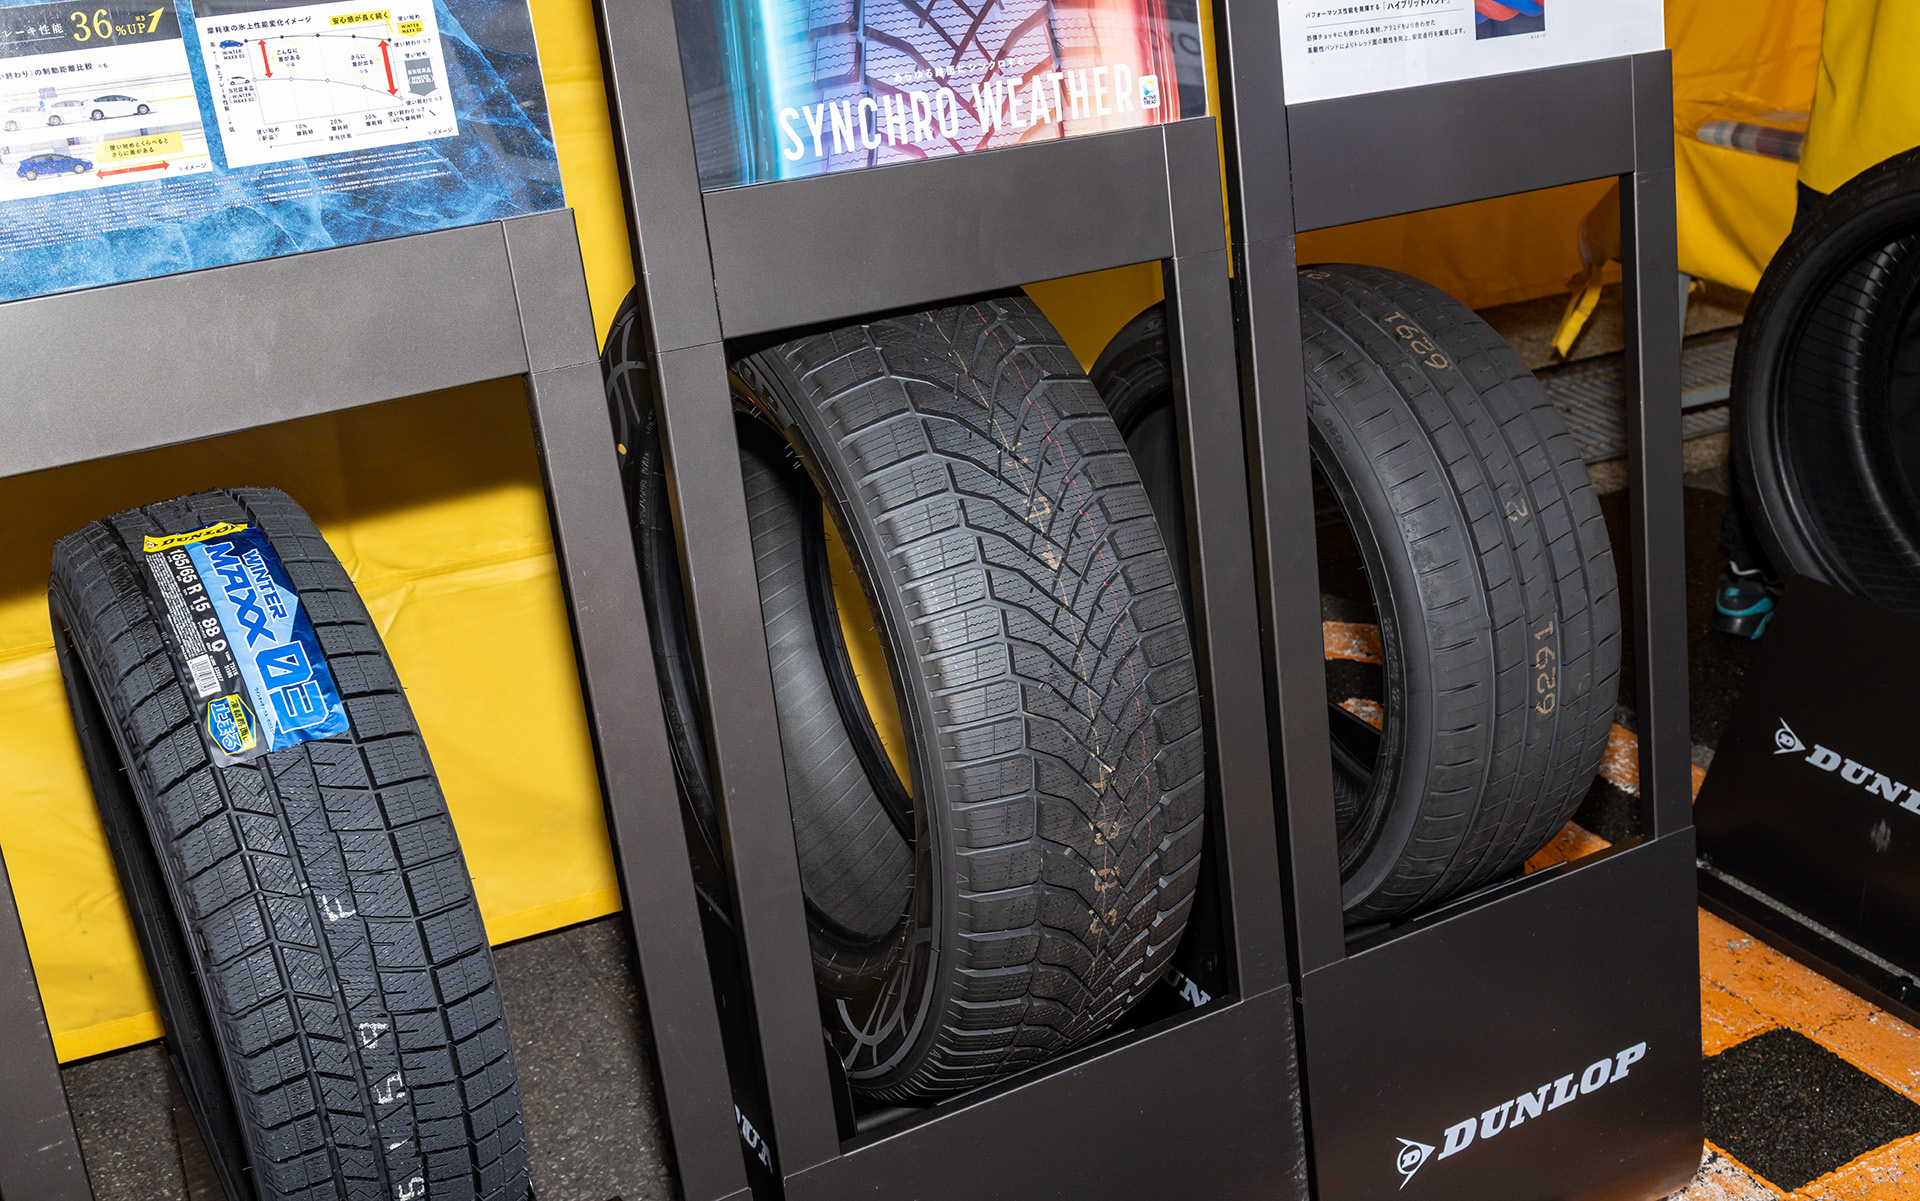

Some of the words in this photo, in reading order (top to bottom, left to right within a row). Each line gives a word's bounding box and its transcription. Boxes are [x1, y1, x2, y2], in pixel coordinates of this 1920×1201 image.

[206, 16, 312, 35] 摩耗後の氷上性能変化イメージ
[331, 11, 388, 25] 安心感が長く続く
[893, 57, 1025, 83] あらゆる路面にシンクロする
[778, 87, 959, 162] SYNCHRO
[972, 63, 1133, 133] WEATHER
[170, 548, 198, 586] 185/65
[242, 548, 288, 623] WINTER
[187, 584, 203, 595] R
[192, 596, 210, 612] 15
[203, 541, 279, 652] MAXX
[202, 617, 221, 639] 88
[211, 639, 227, 653] Q
[1534, 621, 1556, 714] 6291
[210, 702, 242, 751] 止まる
[1805, 743, 1920, 816] DUNL
[1437, 1041, 1647, 1161] DUNLOP
